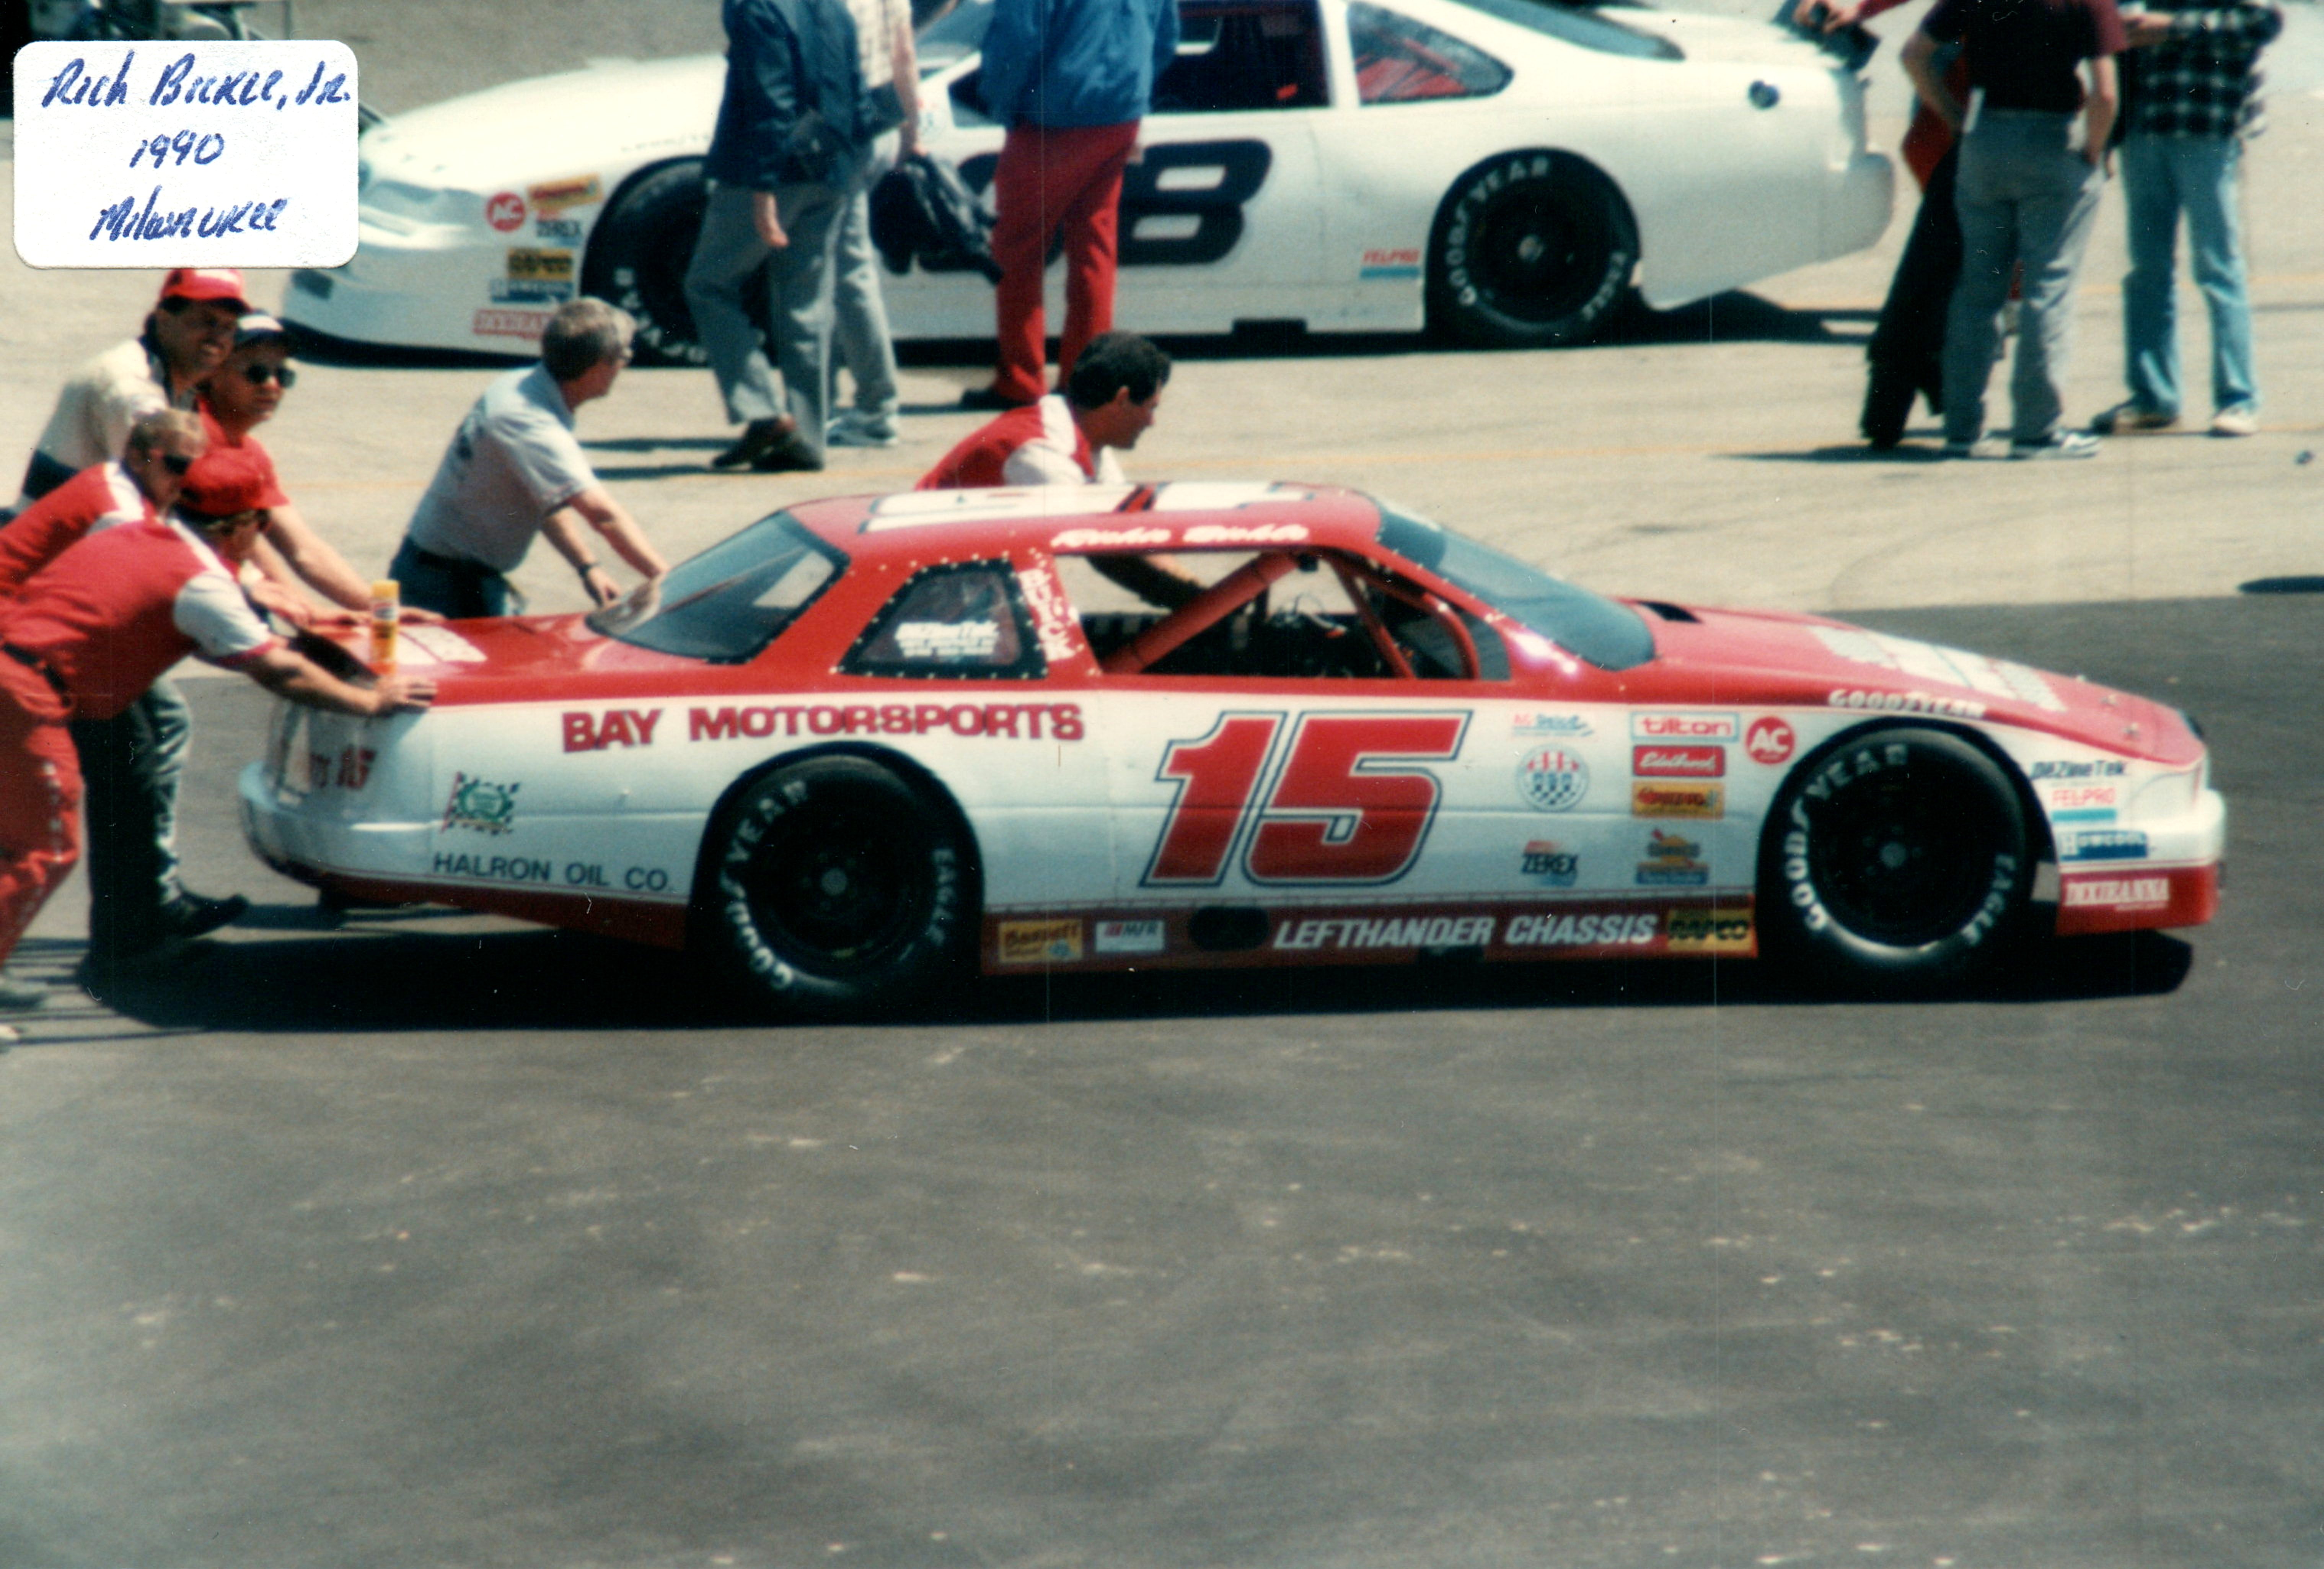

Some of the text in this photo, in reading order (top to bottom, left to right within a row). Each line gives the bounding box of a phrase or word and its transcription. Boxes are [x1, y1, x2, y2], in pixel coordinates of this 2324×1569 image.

[41, 49, 135, 107] Rich
[295, 60, 351, 105] Jr.
[129, 129, 225, 169] 1990
[1829, 689, 1986, 718] GOODYEAR
[562, 704, 1084, 753] BAY MOTORSPORTS
[1642, 716, 1732, 736] tilton
[1750, 726, 1789, 752] AC
[1137, 710, 1474, 888] 15
[1784, 743, 1909, 932] GOODYEAR
[433, 851, 552, 882] HALRON
[564, 862, 609, 887] OIL
[720, 780, 808, 990] GOODYEAR
[1273, 917, 1496, 949] LEFTHANDER
[1505, 914, 1659, 946] CHASSIS
